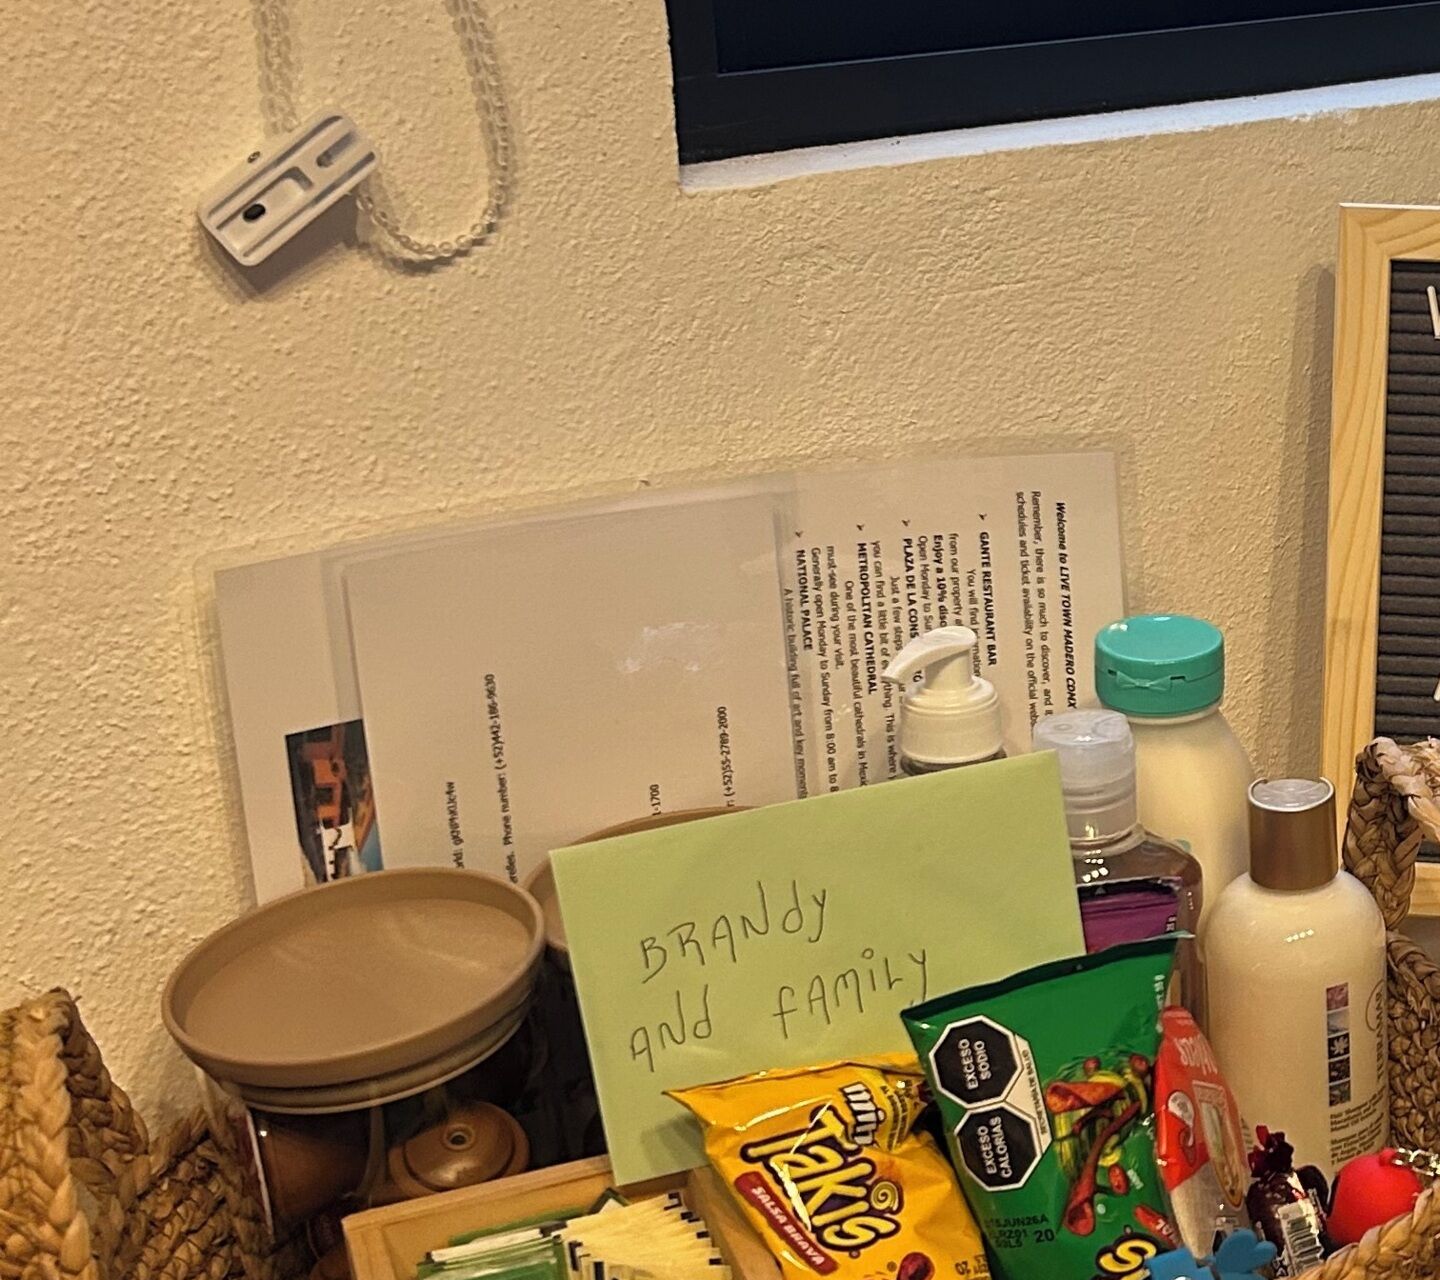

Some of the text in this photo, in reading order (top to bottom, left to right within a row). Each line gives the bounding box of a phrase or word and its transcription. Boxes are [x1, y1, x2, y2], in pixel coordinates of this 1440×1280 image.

[1016, 492, 1028, 537] schedules
[1031, 491, 1043, 545] Remember,
[872, 541, 882, 558] you
[903, 538, 914, 572] PLAZA
[918, 536, 928, 560] Open
[932, 535, 944, 564] Enjoy
[949, 533, 959, 555] from
[1020, 540, 1030, 557] and
[811, 548, 823, 591] Generally
[874, 561, 883, 577] can
[951, 558, 959, 574] our
[1035, 548, 1045, 573] there
[906, 575, 915, 590] DE
[919, 564, 931, 600] Monday
[967, 569, 976, 587] You
[1021, 560, 1031, 585] ticket
[1037, 576, 1045, 584] is
[796, 550, 813, 650] NATIONAL PALACE
[844, 581, 854, 600] One
[876, 581, 886, 598] find
[907, 593, 916, 605] LA
[937, 577, 947, 602] 10%
[950, 577, 963, 616] property
[968, 589, 978, 605] will
[980, 532, 997, 665] GANTE RESTAURANT BAR
[1038, 588, 1046, 598] so
[813, 594, 824, 618] open
[827, 546, 844, 669] must-see during your visit.
[846, 603, 856, 612] of
[923, 603, 932, 613] to
[1022, 588, 1034, 635] availability
[1038, 602, 1048, 627] much
[1056, 502, 1076, 708] Welcome to LIVE TOWN MADERO CDMX
[847, 615, 856, 630] the
[857, 543, 877, 694] METROPOLITAN CATHEDRAL
[878, 610, 888, 630] little
[969, 608, 979, 625] find
[815, 621, 827, 657] Monday
[849, 633, 858, 656] most
[879, 633, 889, 645] bit
[1025, 639, 1034, 650] on
[1040, 631, 1049, 641] to
[881, 648, 890, 657] of
[1026, 653, 1036, 668] the
[819, 660, 828, 670] to
[1040, 645, 1052, 685] discover,
[819, 672, 831, 706] Sunday
[851, 659, 862, 699] beautiful
[1028, 671, 1038, 700] official
[1043, 689, 1053, 706] and
[824, 709, 834, 731] from
[853, 702, 866, 748] cathedrals
[885, 713, 895, 732] This
[826, 734, 836, 754] 8:00
[858, 751, 867, 759] in
[827, 757, 836, 772] am
[887, 745, 897, 773] where
[829, 774, 838, 784] to
[958, 1038, 979, 1090] EXCESO
[974, 1040, 992, 1081] SODIO
[977, 1125, 997, 1174] EXCESO
[751, 1185, 826, 1266] SALSA BRAVA
